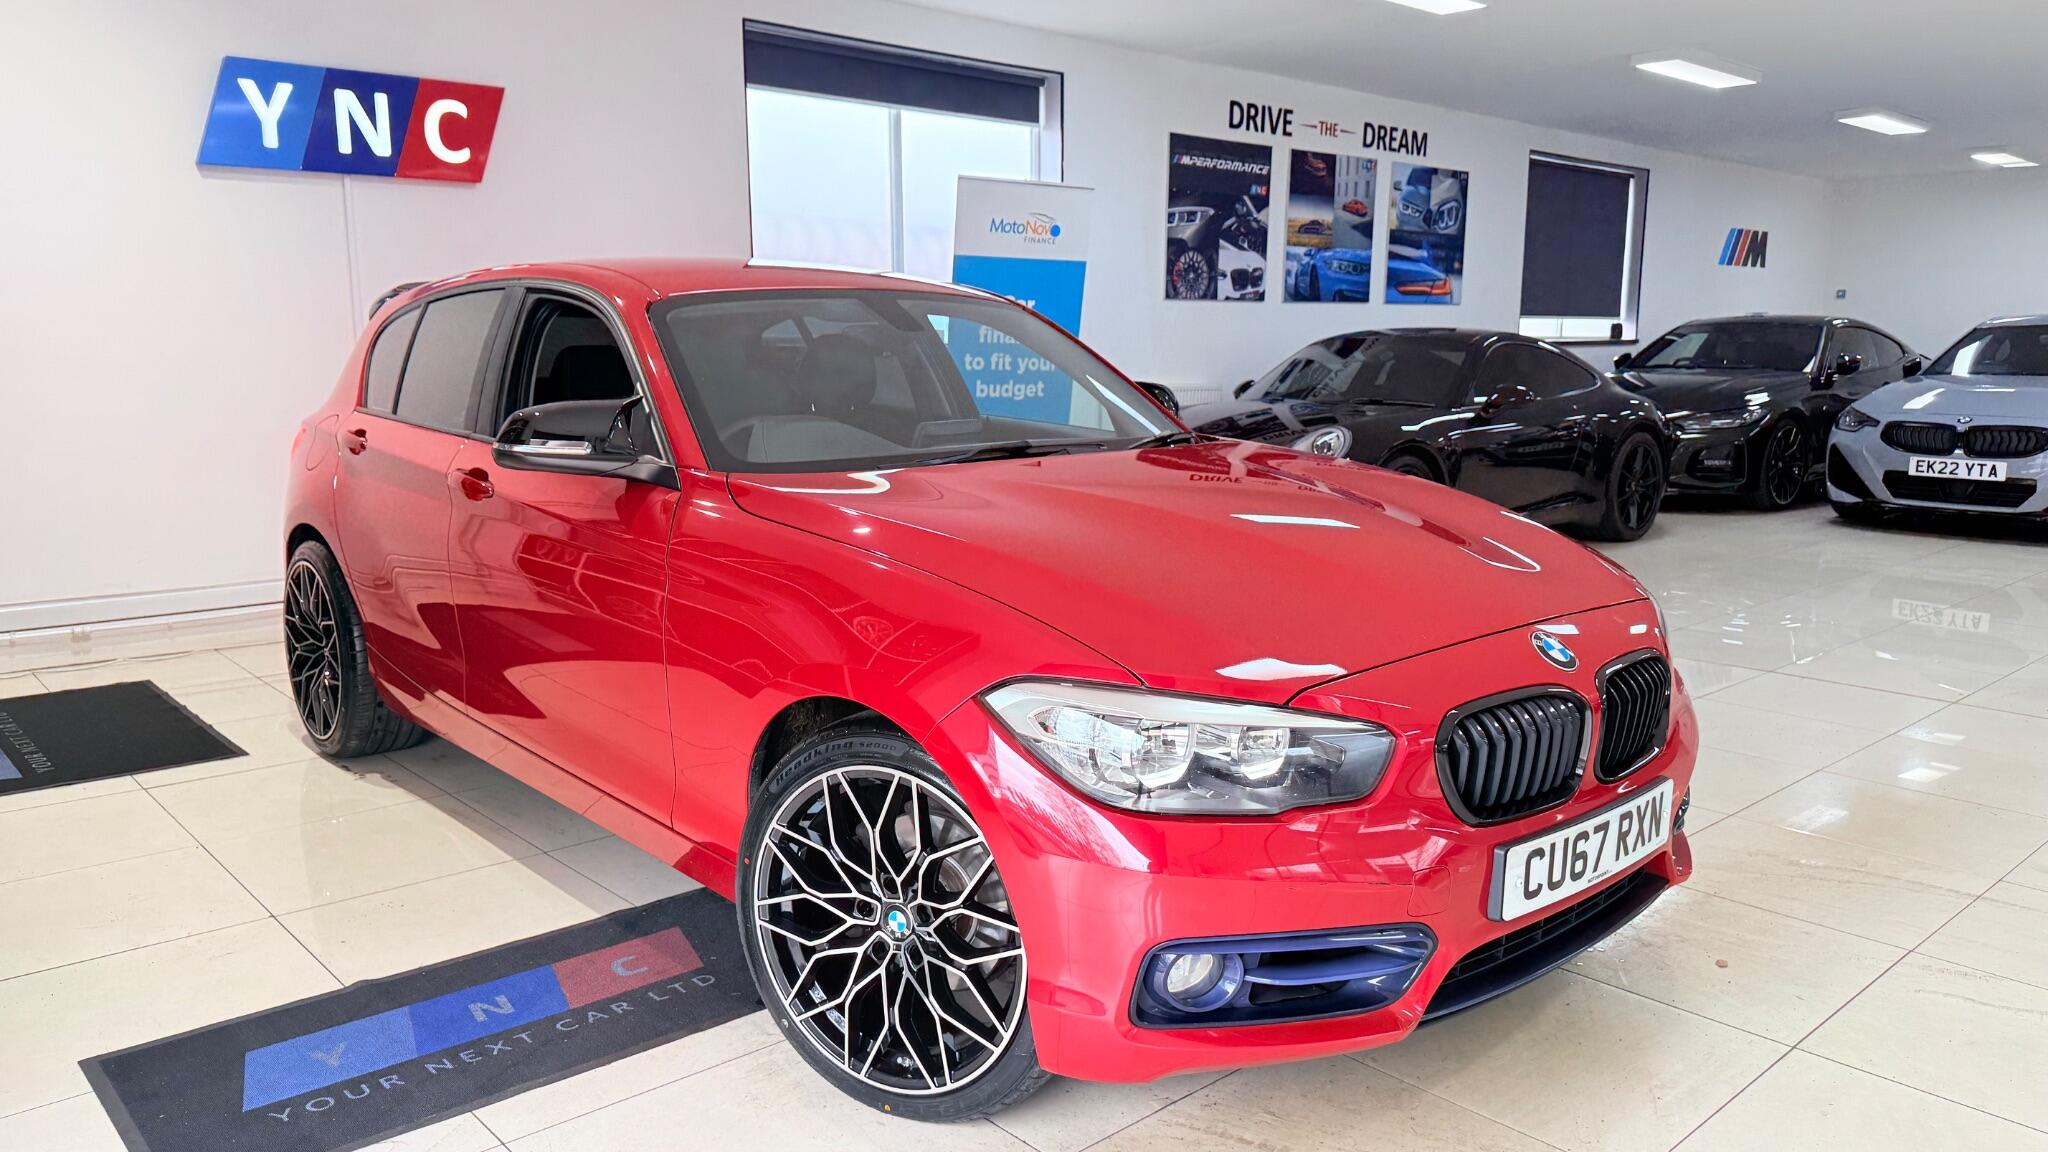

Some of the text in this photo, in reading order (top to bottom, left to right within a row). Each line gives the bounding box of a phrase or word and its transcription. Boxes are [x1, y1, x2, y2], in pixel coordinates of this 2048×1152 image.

[236, 78, 471, 164] YNC
[1228, 100, 1428, 157] DRIVE THE DREAM
[1024, 236, 1056, 245] FINANCE
[964, 353, 985, 371] to
[991, 353, 1012, 371] fit
[975, 379, 1045, 400] budget
[1915, 459, 1998, 479] EK22 YTA
[1523, 791, 1664, 901] CU67 RXN
[268, 973, 717, 1122] YOUR NEXT CAR LTD
